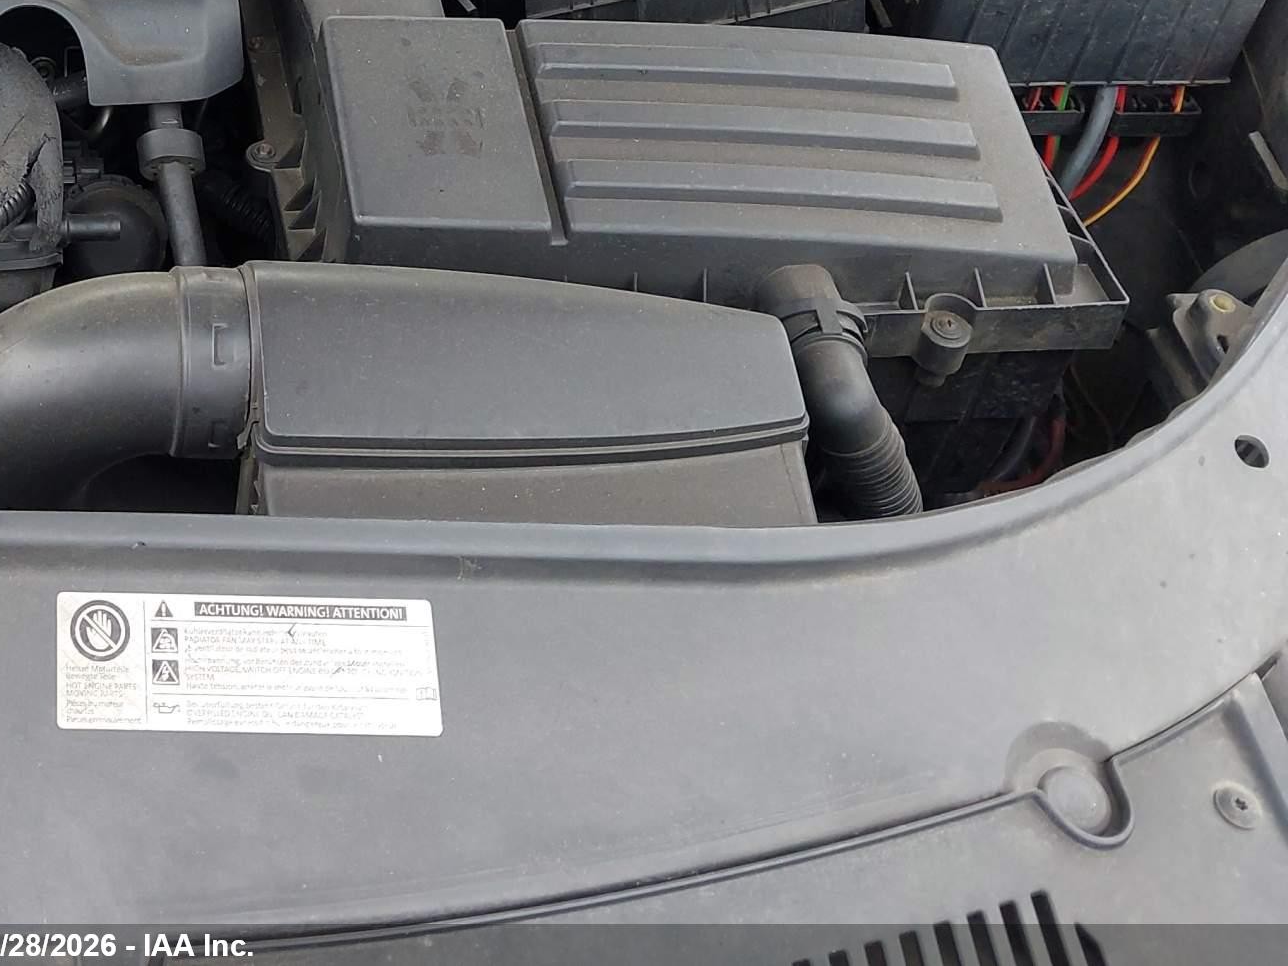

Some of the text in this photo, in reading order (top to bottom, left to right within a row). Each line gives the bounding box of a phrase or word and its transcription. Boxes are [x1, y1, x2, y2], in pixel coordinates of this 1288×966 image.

[198, 603, 403, 620] ACHTUNG! WARNING! ATTENTION!
